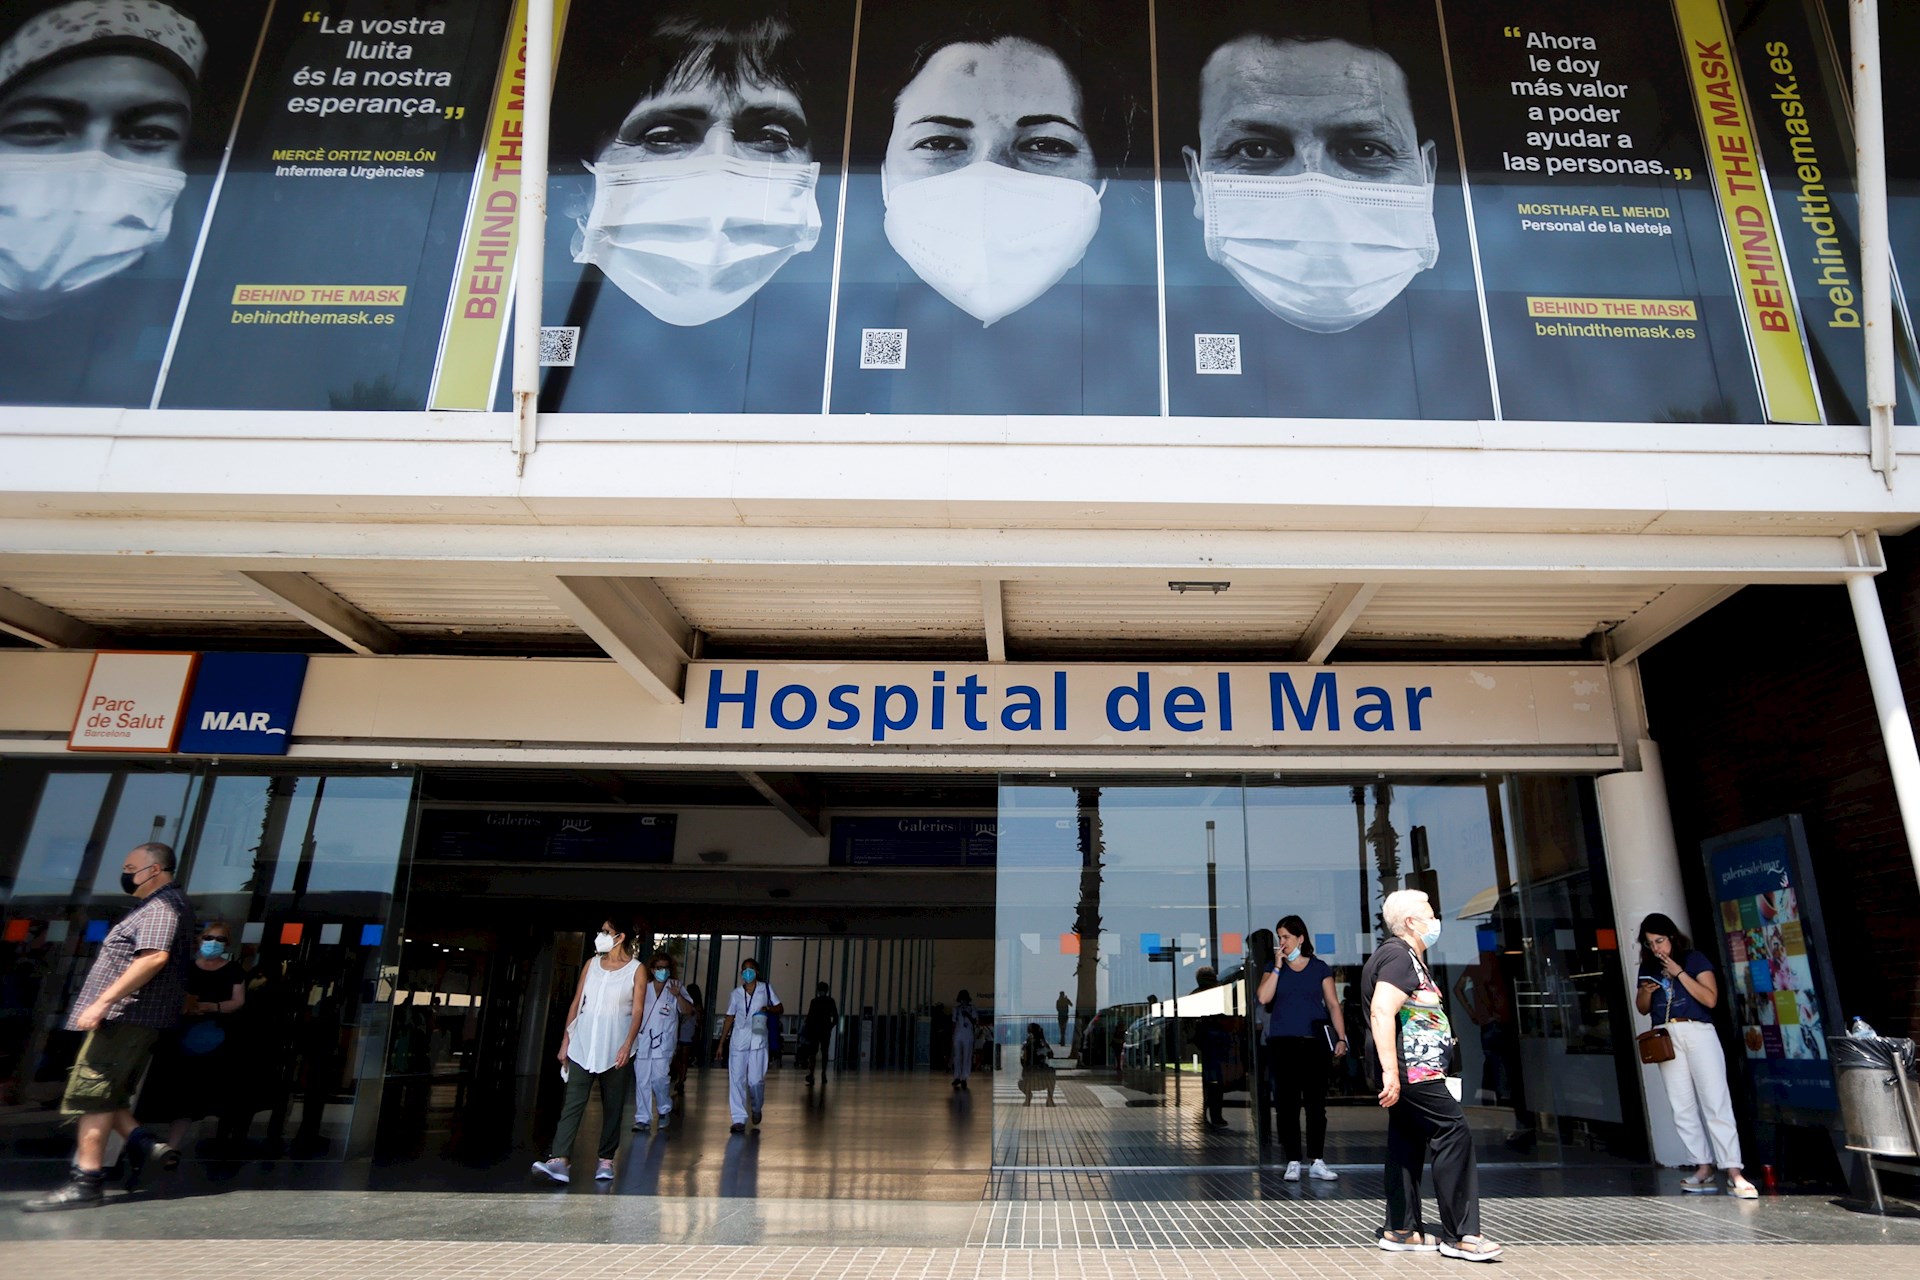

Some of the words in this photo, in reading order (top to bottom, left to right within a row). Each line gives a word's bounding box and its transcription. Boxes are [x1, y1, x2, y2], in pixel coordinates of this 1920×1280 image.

[361, 19, 445, 35] vostra
[346, 41, 412, 59] lluita
[1530, 56, 1552, 72] le
[1556, 57, 1600, 77] doy
[293, 68, 326, 86] és
[332, 68, 356, 86] la
[363, 71, 451, 87] nostra
[1695, 40, 1740, 127] MASK
[1511, 79, 1563, 96] más
[1568, 80, 1627, 98] valor
[1528, 107, 1543, 121] a
[1550, 105, 1620, 125] poder
[1526, 129, 1611, 150] ayudar
[1617, 134, 1632, 149] a
[272, 148, 326, 161] MERCÈ
[328, 151, 372, 161] ORTIZ
[374, 149, 436, 162] NOBLÓN
[1503, 152, 1540, 172] las
[275, 165, 347, 178] Infermera
[350, 166, 424, 179] Urgències
[1719, 136, 1756, 197] THE
[1766, 42, 1861, 328] behindthemask.es
[464, 191, 517, 319] BEHIND
[492, 120, 522, 181] THE
[1518, 204, 1598, 217] MOSTHAFA
[1601, 206, 1620, 217] EL
[1622, 207, 1670, 218] MEHDI
[1522, 220, 1585, 233] Personal
[1588, 222, 1607, 233] de
[1610, 222, 1622, 233] la
[1625, 223, 1671, 235] Neteja
[1736, 206, 1790, 333] BEHIND
[238, 289, 305, 301] BEHIND
[311, 290, 346, 302] THE
[349, 290, 399, 302] MASK
[231, 311, 394, 324] behindthemask.es
[1533, 301, 1598, 315] BEHIND
[1603, 303, 1636, 316] THE
[1642, 304, 1691, 317] MASK
[1536, 322, 1695, 339] behindthemask.es
[92, 696, 135, 711] Parc
[705, 669, 1068, 741] Hospital
[1105, 671, 1231, 733] del
[1270, 671, 1433, 733] Mar
[88, 714, 110, 728] de
[116, 714, 165, 729] Salut
[201, 712, 270, 731] MAR
[85, 730, 131, 738] Barcelona
[487, 813, 541, 827] Galeries
